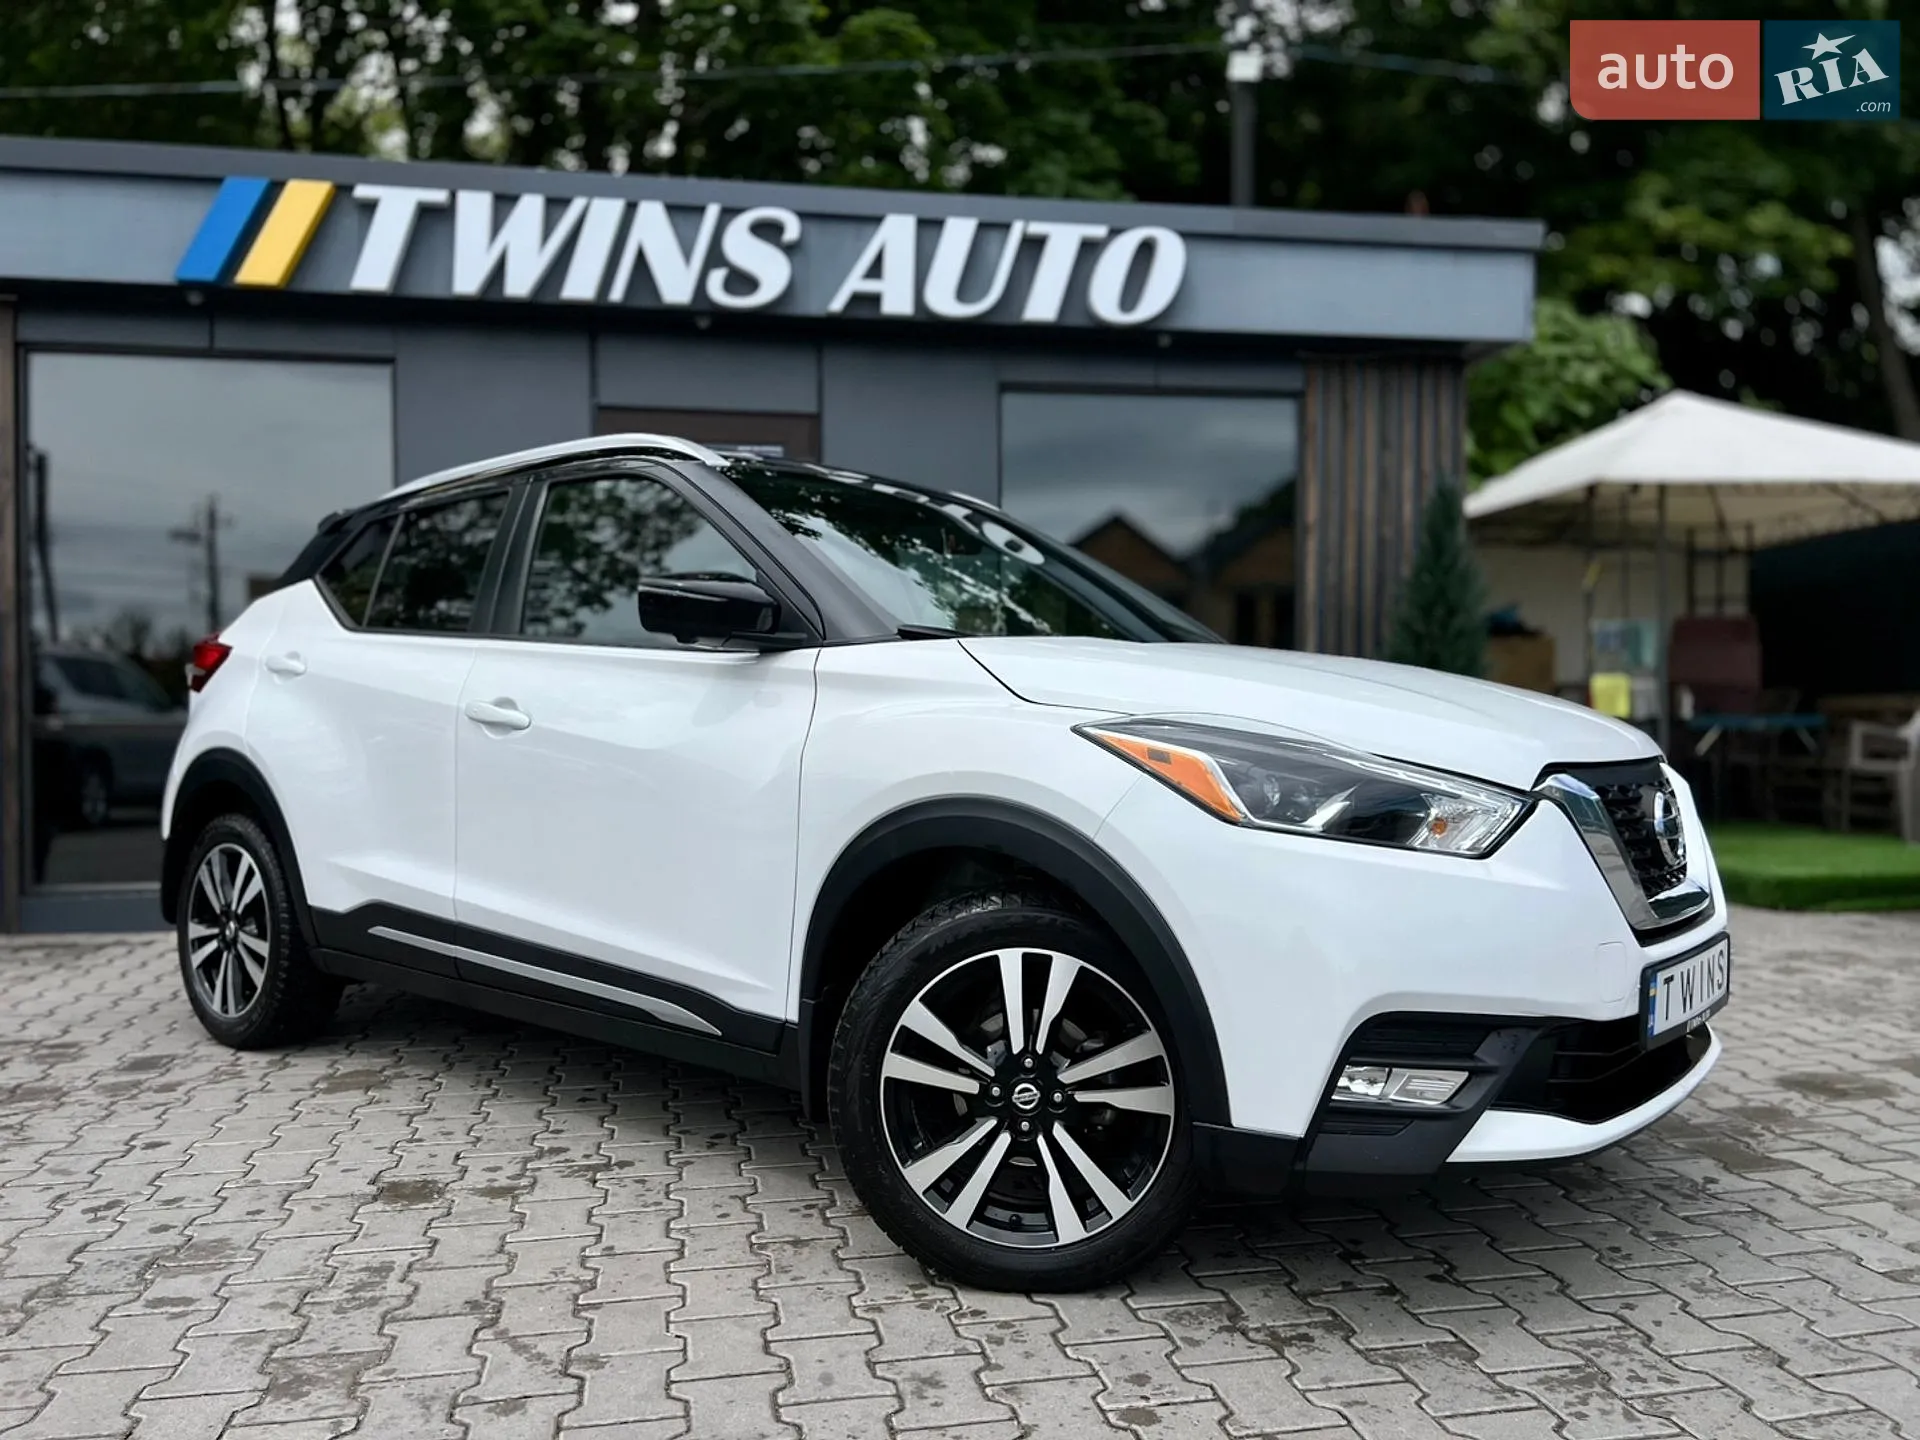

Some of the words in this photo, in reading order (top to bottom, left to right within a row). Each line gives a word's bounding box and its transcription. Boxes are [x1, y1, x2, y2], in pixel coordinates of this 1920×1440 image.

[349, 183, 802, 309] TWINS
[826, 213, 1188, 325] AUTO
[1663, 949, 1724, 1021] TWINS
